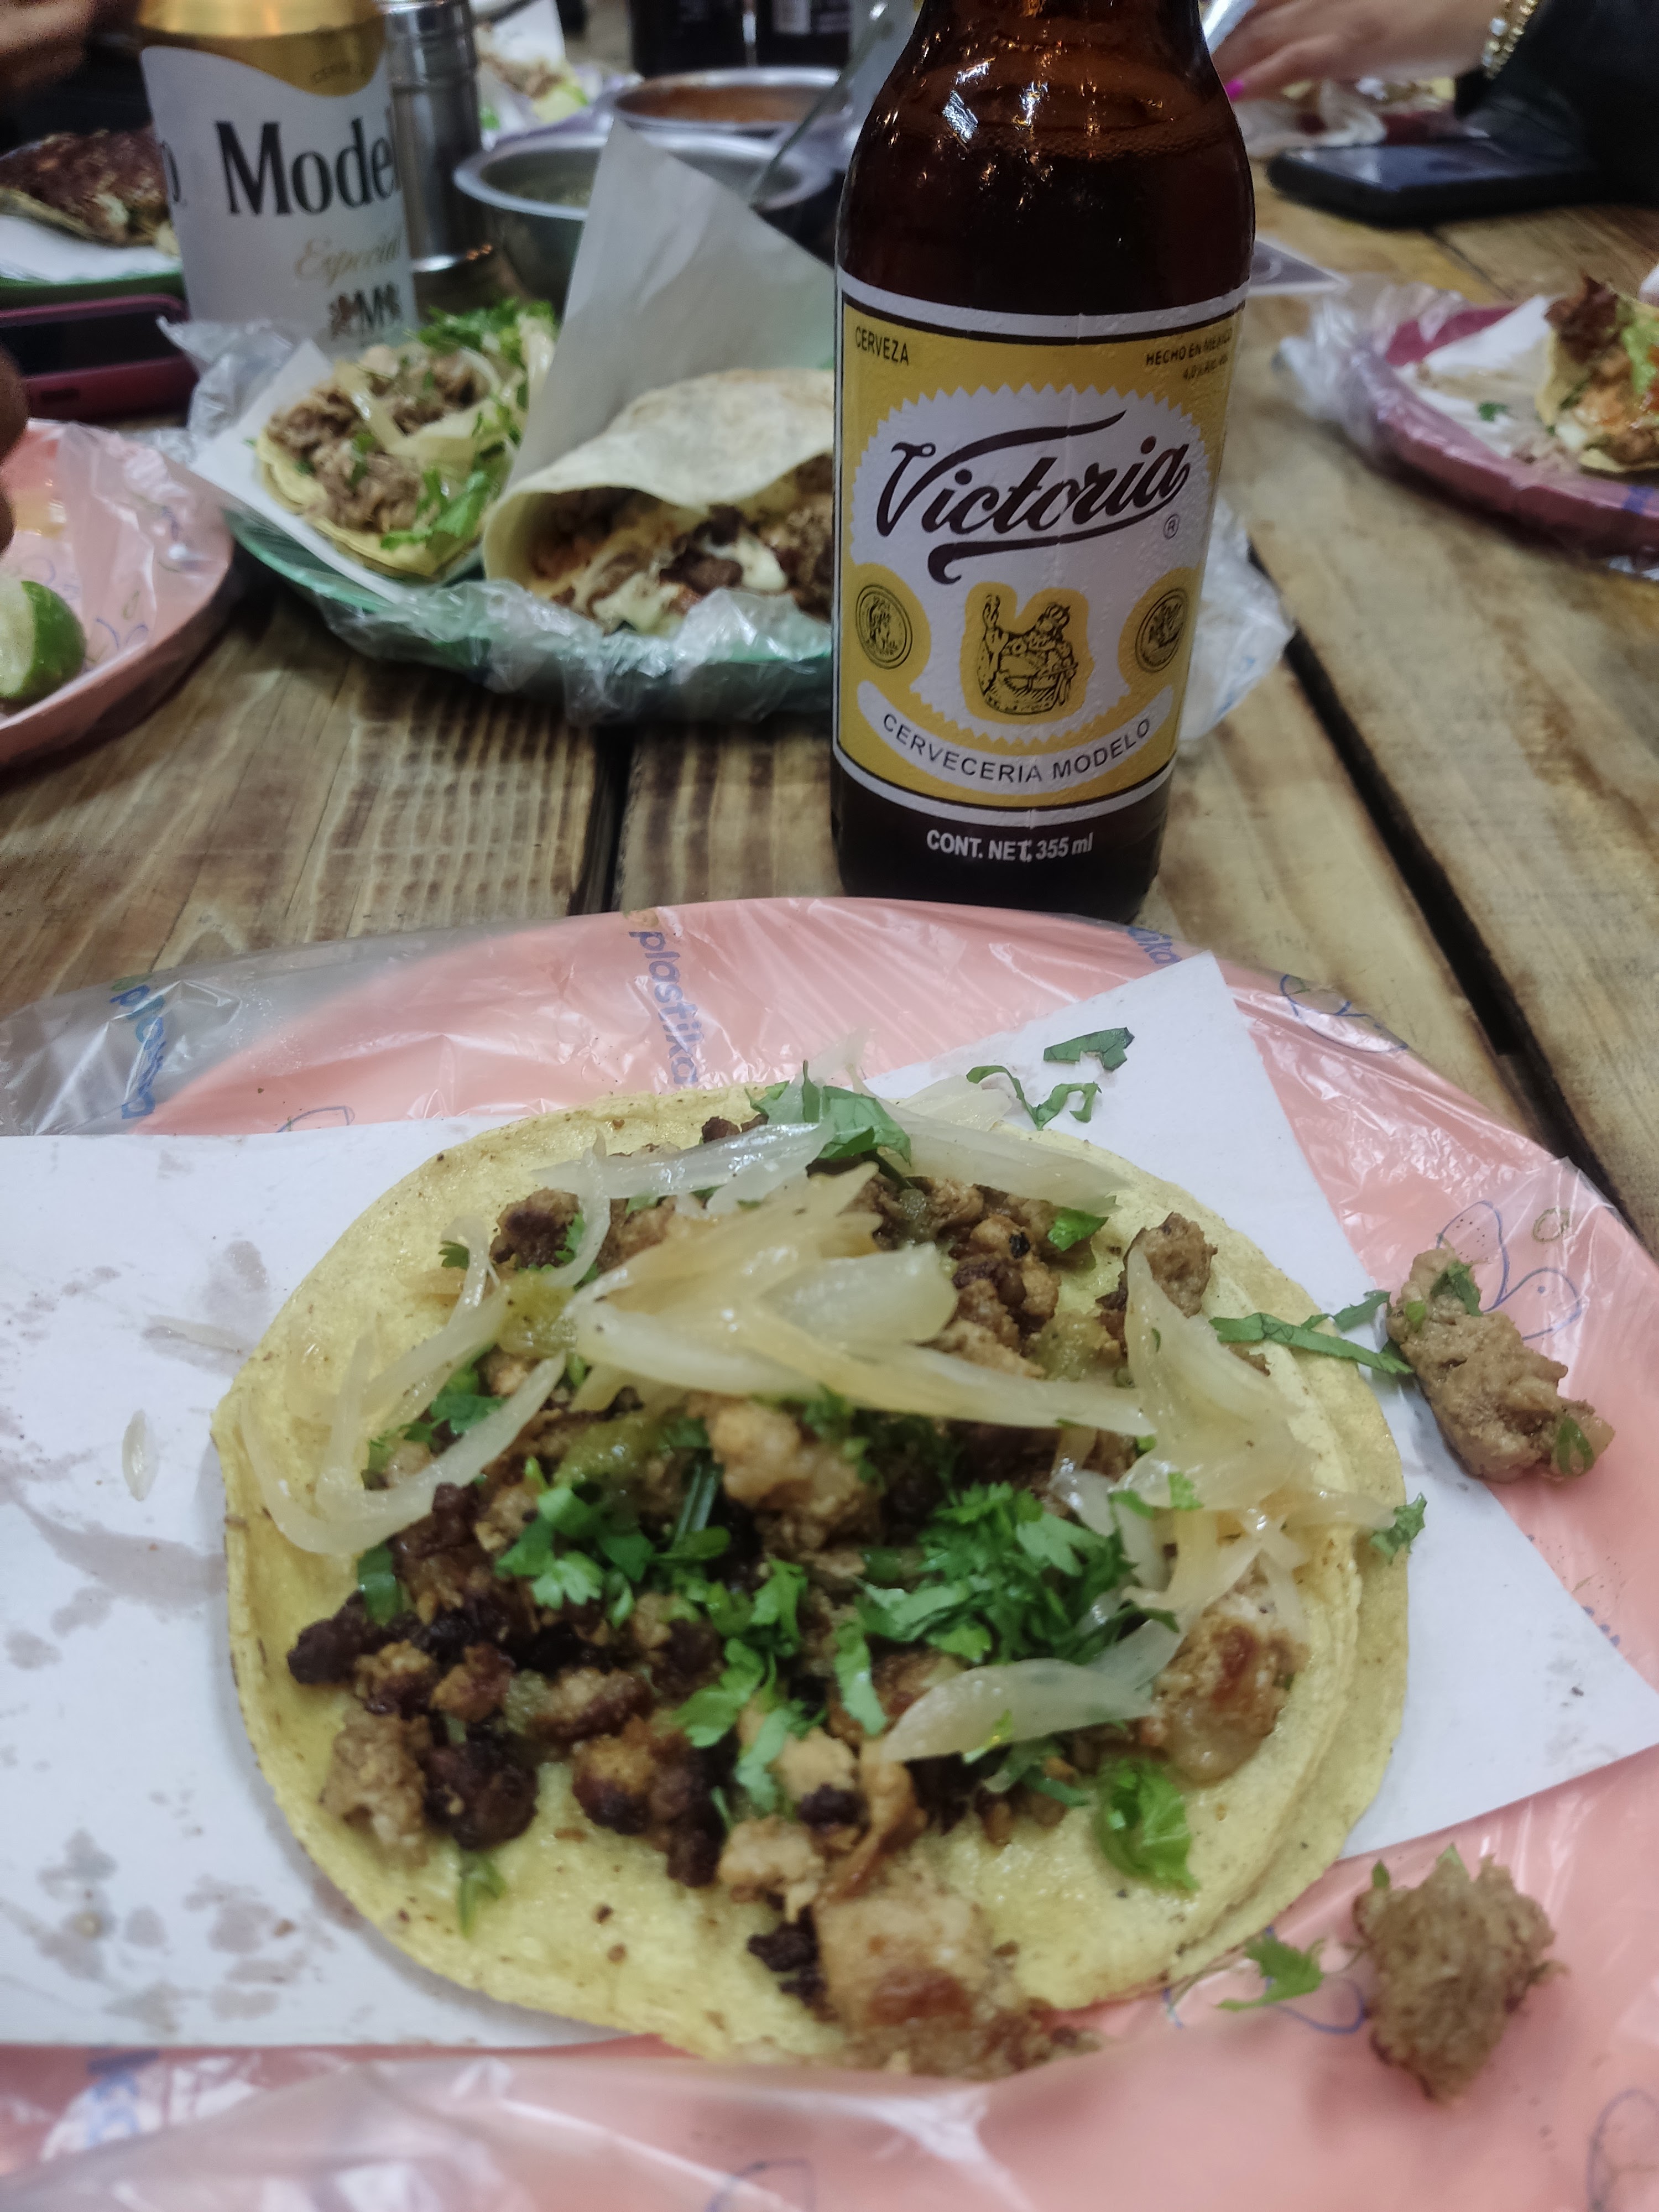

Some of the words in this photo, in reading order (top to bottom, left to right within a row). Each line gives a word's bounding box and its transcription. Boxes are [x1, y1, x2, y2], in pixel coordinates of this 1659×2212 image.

[855, 326, 909, 366] CERVEZA
[1146, 346, 1187, 366] HECHO
[1189, 343, 1202, 358] EN
[877, 410, 1191, 584] Victoria
[883, 714, 1042, 783] CERVECERIA
[1052, 719, 1151, 780] MODELO
[927, 830, 983, 859] CONT.
[1035, 837, 1070, 860] 355
[1072, 832, 1094, 855] ml
[629, 931, 704, 1085] plastika
